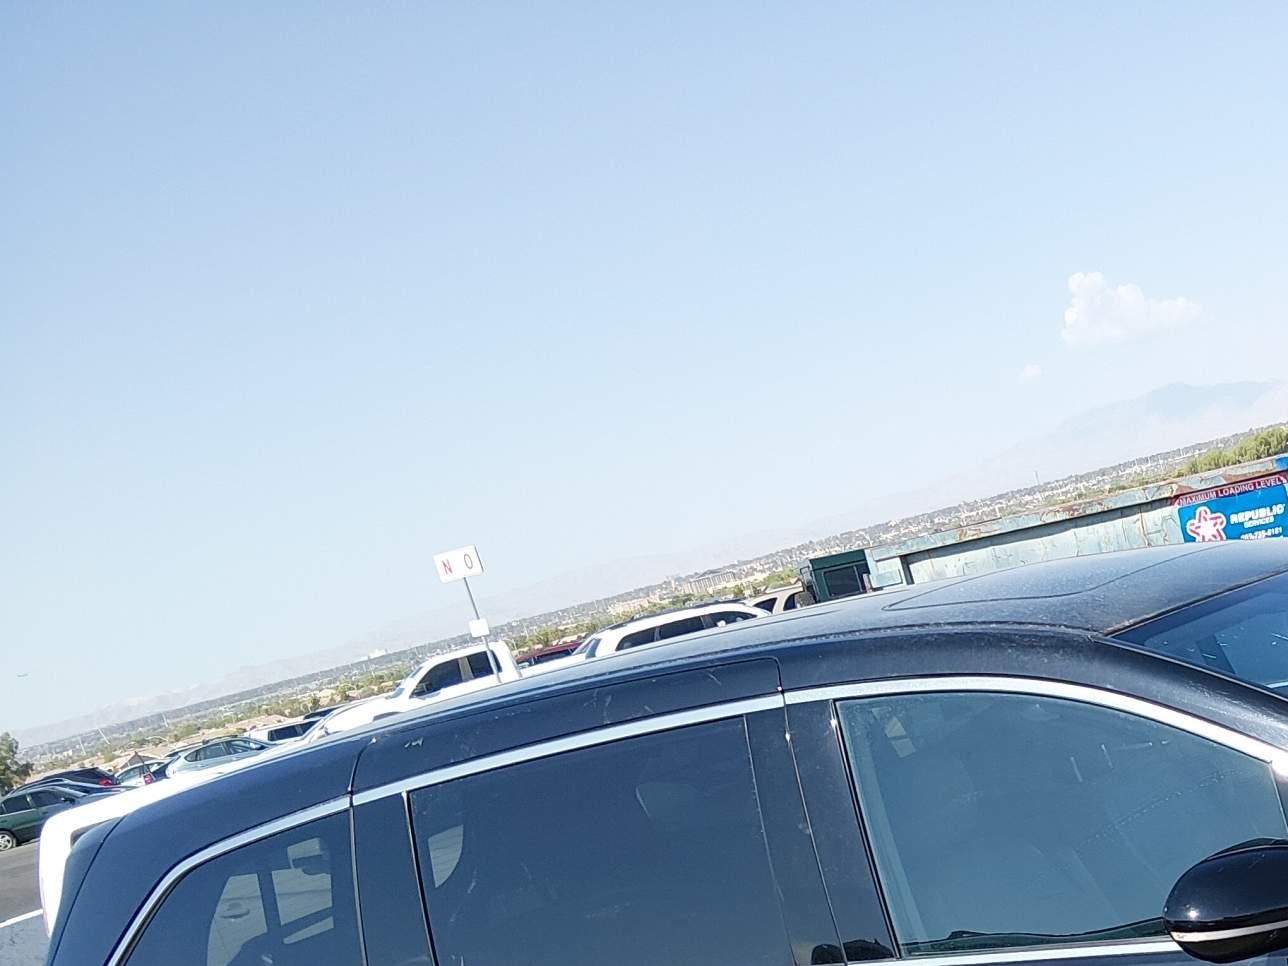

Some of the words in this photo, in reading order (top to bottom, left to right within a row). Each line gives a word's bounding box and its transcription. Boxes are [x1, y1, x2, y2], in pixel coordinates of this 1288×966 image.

[1180, 492, 1217, 506] MAXIMUM
[1219, 483, 1254, 497] LOADING
[1256, 478, 1281, 489] LEVEL
[441, 559, 453, 575] N
[463, 552, 474, 570] O
